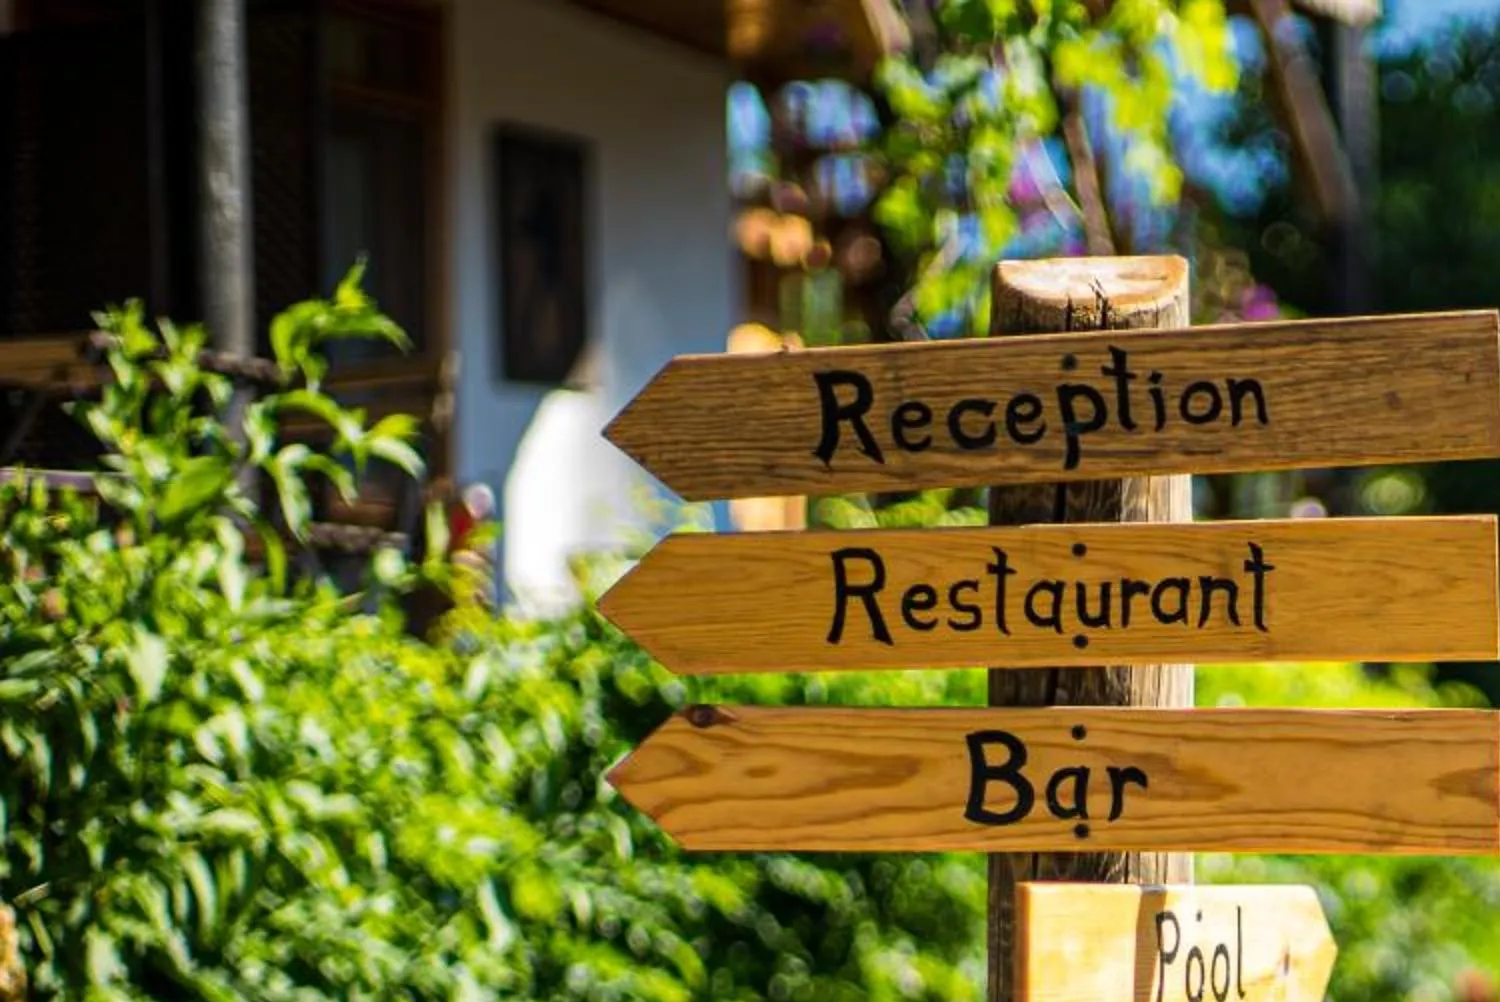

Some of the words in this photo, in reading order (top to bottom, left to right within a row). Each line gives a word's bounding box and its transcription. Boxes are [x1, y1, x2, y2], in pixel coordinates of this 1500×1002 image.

[811, 346, 1269, 470] Reception
[826, 541, 1276, 646] Restaurant
[963, 729, 1149, 827] Bar
